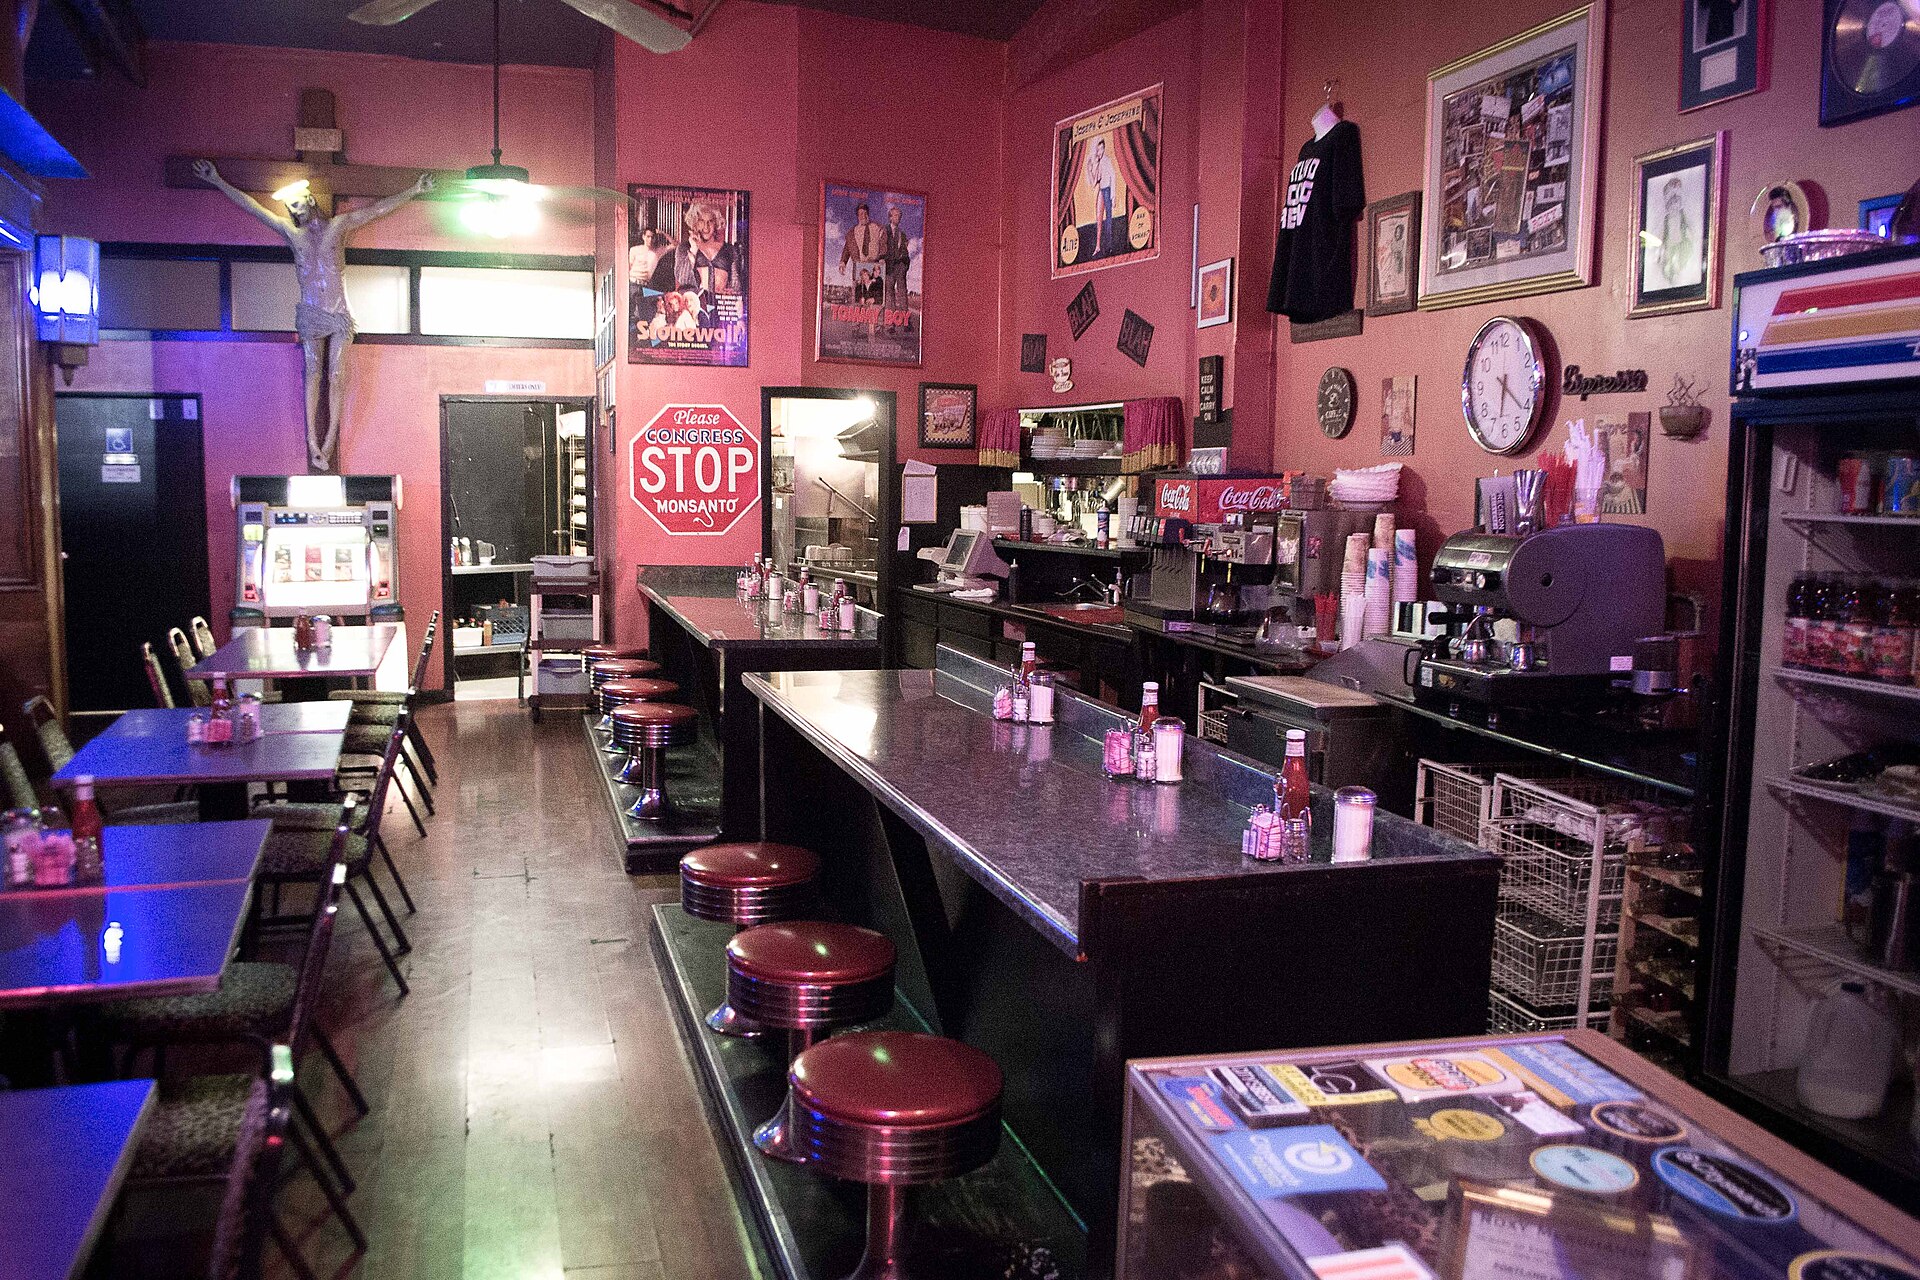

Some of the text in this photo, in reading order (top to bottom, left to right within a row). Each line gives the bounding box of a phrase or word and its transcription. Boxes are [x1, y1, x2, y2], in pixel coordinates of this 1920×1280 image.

[830, 304, 912, 327] TOMMY BOY
[1490, 340, 1499, 355] 11
[1500, 332, 1510, 348] 12
[1516, 337, 1521, 351] 1
[1480, 357, 1492, 374] 10
[1524, 352, 1532, 368] 2
[1200, 374, 1214, 384] KEEP
[1200, 385, 1214, 395] CALM
[1476, 381, 1484, 396] 9
[1199, 401, 1216, 412] CARRY
[1481, 402, 1489, 418] 8
[1522, 398, 1531, 411] 4
[673, 408, 720, 425] Please
[1203, 412, 1212, 422] ON
[1513, 416, 1522, 432] 5
[1489, 417, 1497, 433] 7
[1501, 424, 1509, 439] 6
[645, 428, 744, 444] CONGRESS
[639, 446, 754, 493] STOP
[653, 497, 740, 516] MONSANTO
